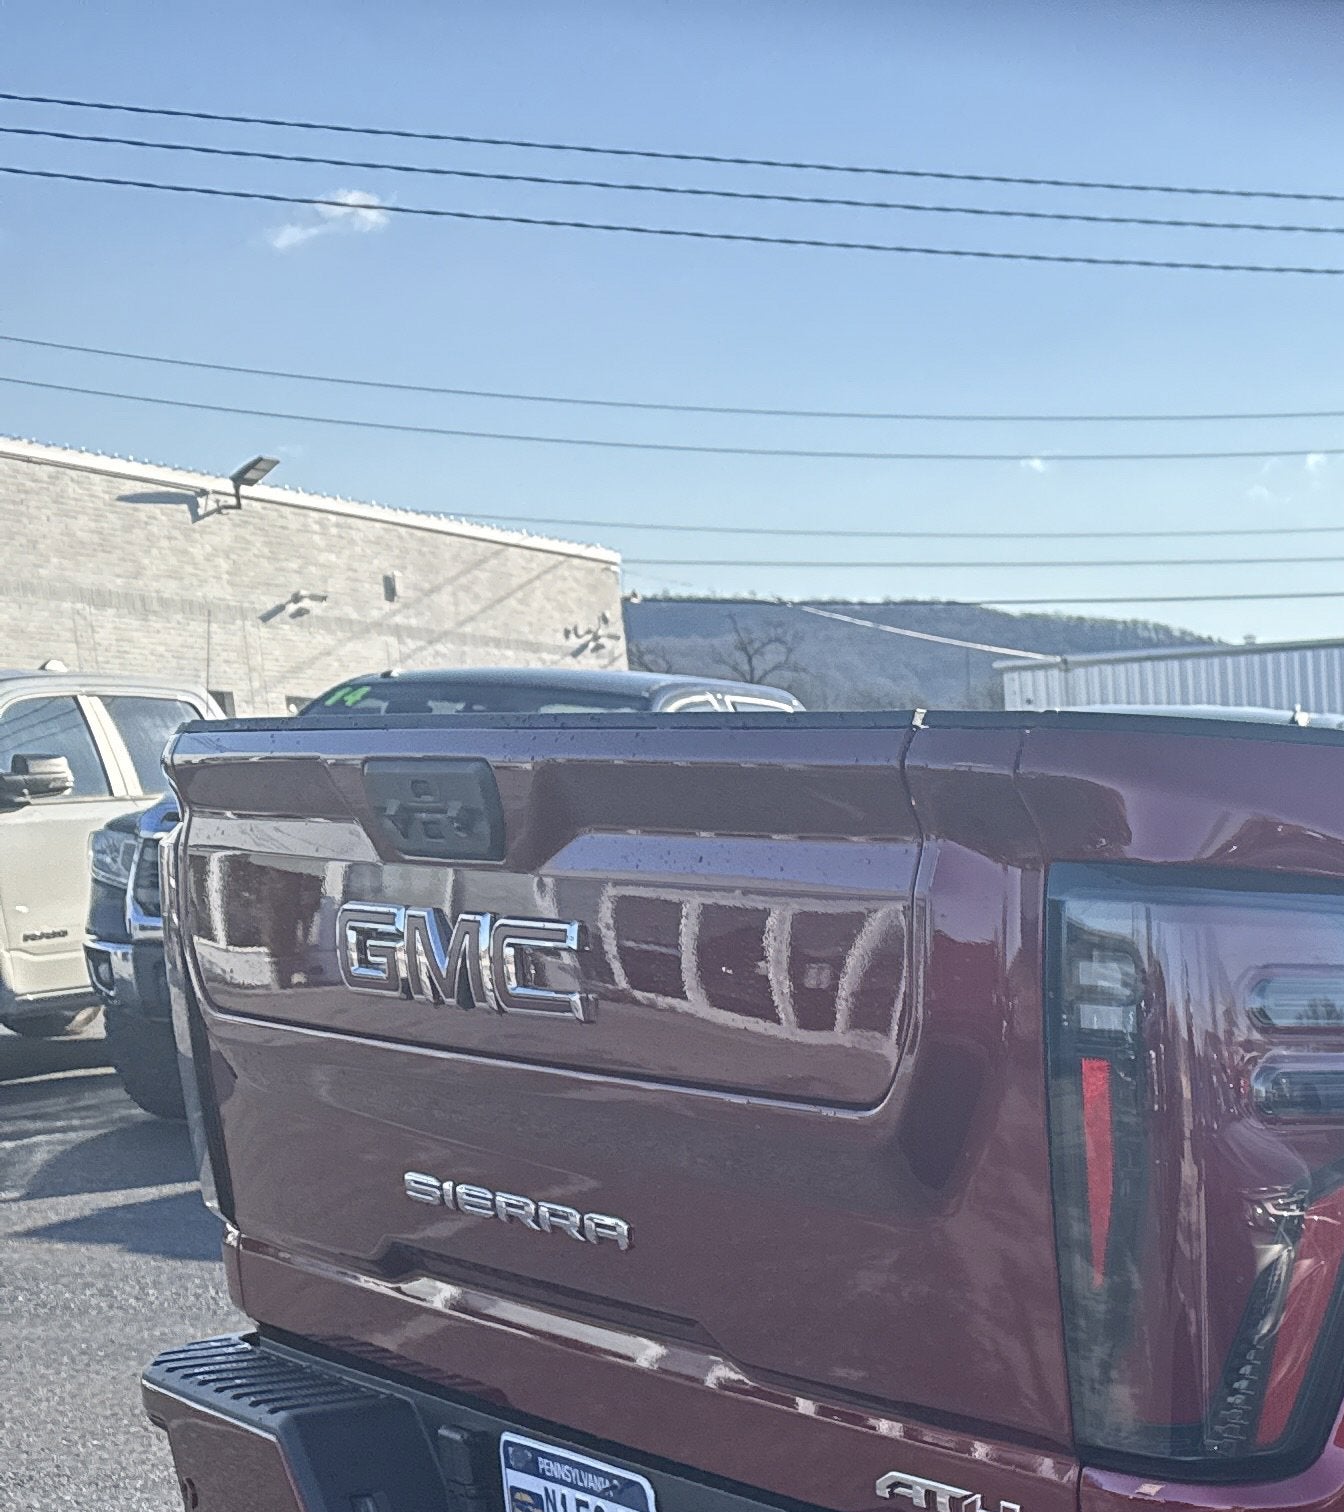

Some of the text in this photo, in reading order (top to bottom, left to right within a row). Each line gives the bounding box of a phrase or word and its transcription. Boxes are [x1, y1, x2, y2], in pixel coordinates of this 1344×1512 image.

[324, 685, 371, 707] 14
[336, 900, 588, 1023] GMC
[404, 1171, 632, 1251] SIERRA
